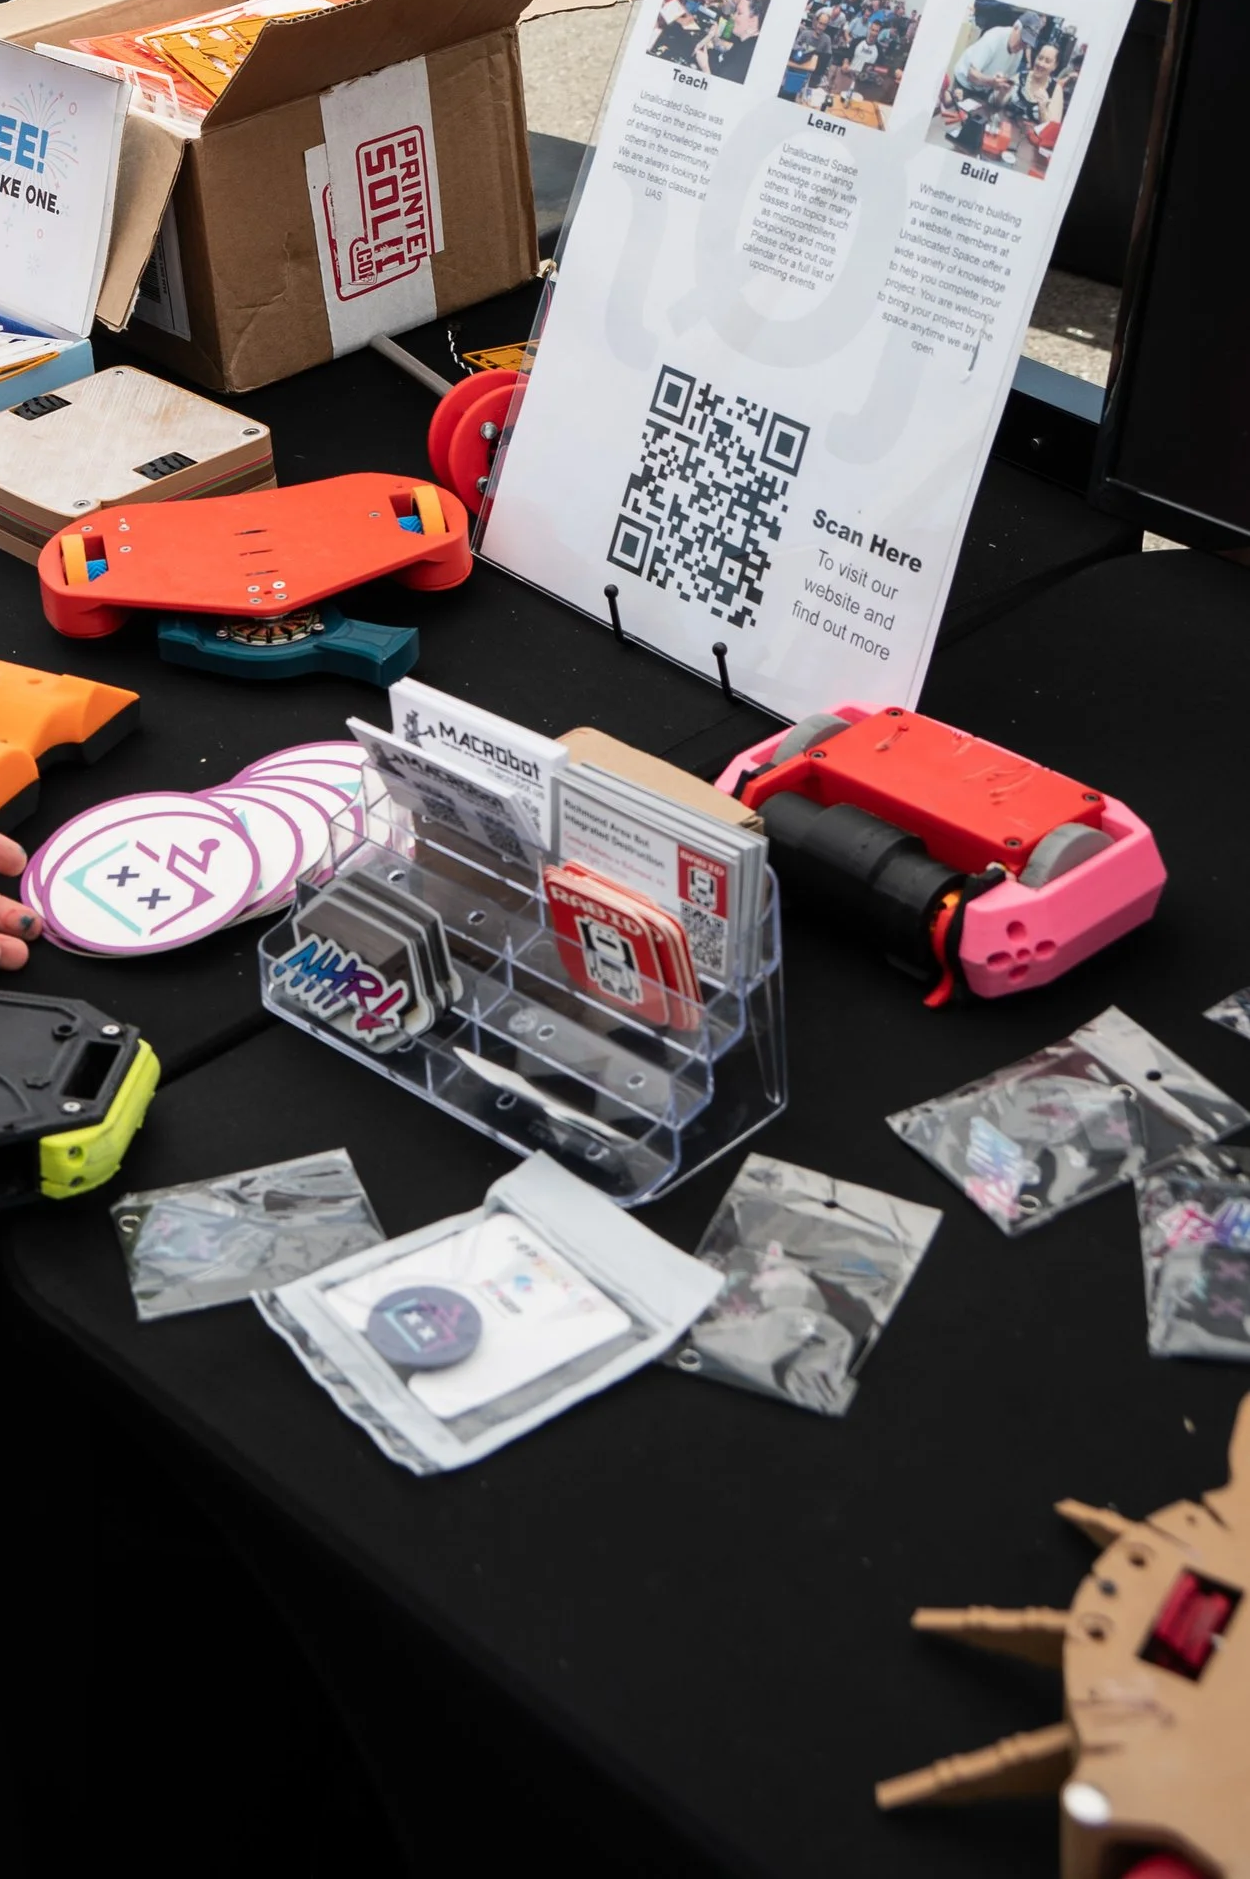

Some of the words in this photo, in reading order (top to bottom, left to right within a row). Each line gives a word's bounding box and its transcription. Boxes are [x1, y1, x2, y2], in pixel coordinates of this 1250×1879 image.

[673, 71, 708, 90] Teach
[633, 103, 662, 120] founded
[686, 123, 722, 141] principles
[640, 91, 683, 112] Unallocated
[683, 104, 707, 120] Space
[625, 134, 647, 148] others
[635, 122, 662, 139] sharing
[662, 130, 702, 151] knowledge
[807, 113, 846, 136] Learn
[644, 157, 669, 171] always
[671, 165, 698, 184] looking
[779, 156, 812, 175] believes
[823, 173, 854, 191] sharing
[783, 143, 830, 167] Unallocated
[831, 159, 858, 176] Space
[961, 162, 998, 184] Build
[613, 162, 637, 176] people
[647, 172, 667, 186] teach
[668, 181, 696, 197] classes
[767, 167, 810, 189] knowledge
[811, 184, 839, 200] openly
[25, 185, 60, 215] ONE.
[759, 193, 789, 209] classes
[802, 207, 827, 223] topics
[828, 217, 848, 231] such
[794, 189, 807, 202] We
[828, 203, 852, 219] many
[920, 184, 956, 203] Whether
[957, 198, 984, 213] you're
[986, 206, 1022, 228] building
[751, 230, 778, 248] Please
[779, 242, 802, 256] check
[753, 217, 796, 242] lockpicking
[950, 213, 981, 230] electric
[983, 225, 1010, 239] guitar
[899, 228, 951, 255] Unallocated
[951, 247, 980, 266] Space
[982, 260, 1003, 272] offer
[956, 233, 998, 254] members
[743, 243, 777, 260] calendar
[798, 261, 811, 273] full
[811, 266, 824, 279] list
[749, 259, 788, 282] upcoming
[894, 246, 914, 259] wide
[917, 254, 946, 273] variety
[957, 267, 1006, 292] knowledge
[899, 264, 918, 279] help
[938, 280, 979, 301] complete
[980, 295, 1001, 308] your
[921, 288, 936, 303] You
[882, 312, 909, 328] space
[909, 323, 945, 342] anytime
[887, 295, 910, 313] bring
[911, 306, 932, 318] your
[932, 313, 964, 331] project
[965, 324, 977, 338] by
[813, 509, 863, 547] Scan
[869, 534, 922, 572] Here
[819, 549, 834, 570] To
[839, 563, 868, 587] visit
[871, 579, 898, 600] our
[805, 578, 860, 614] website
[864, 608, 895, 631] and
[792, 600, 821, 626] find
[823, 619, 847, 640] out
[850, 632, 890, 660] more
[438, 721, 541, 781] MACRObot
[563, 797, 607, 827] Richmond
[610, 822, 632, 840] Area
[634, 833, 650, 847] Bot
[563, 812, 610, 842] Integrated
[611, 834, 666, 870] Destruction
[549, 885, 643, 937] RABID
